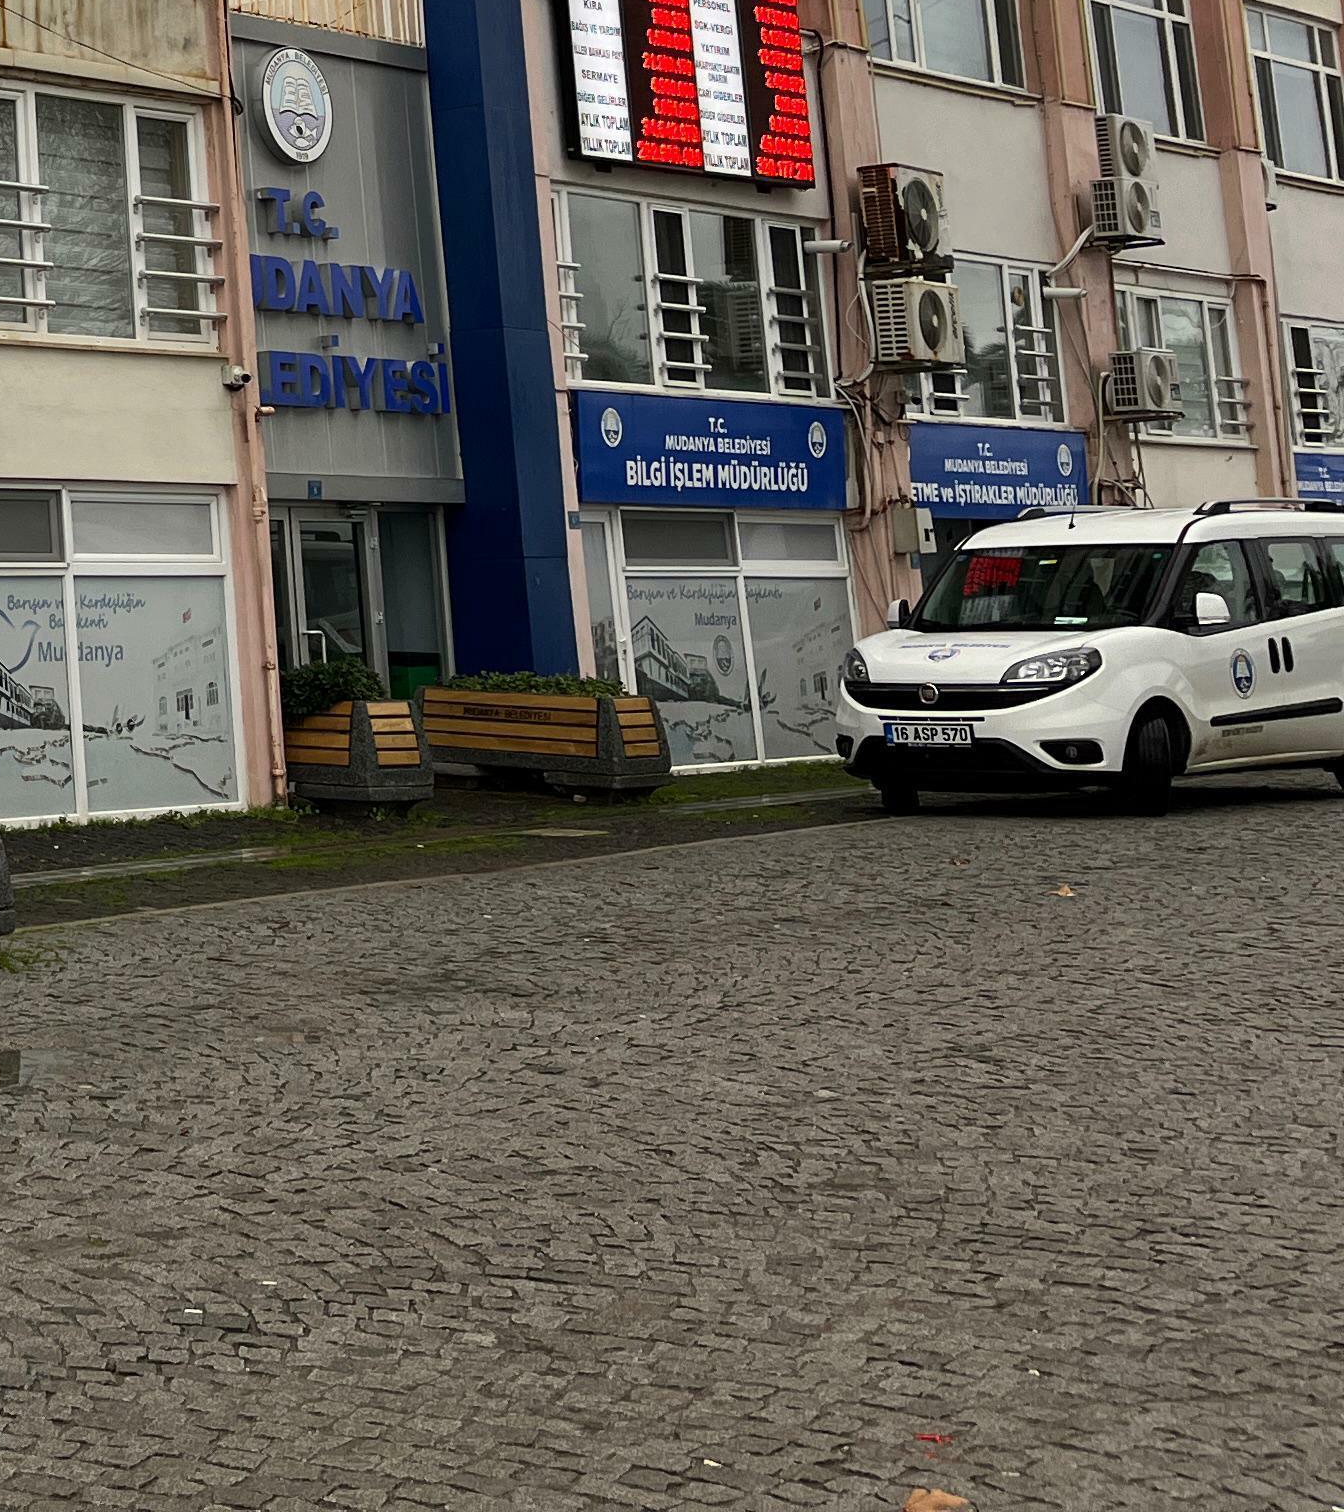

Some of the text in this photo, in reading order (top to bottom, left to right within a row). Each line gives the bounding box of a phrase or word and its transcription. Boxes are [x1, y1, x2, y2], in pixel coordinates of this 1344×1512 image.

[581, 69, 619, 84] SERMAYE
[259, 187, 339, 240] T.C.
[708, 417, 728, 433] T.C.
[665, 434, 771, 455] MUDANYA BELEDİYESİ
[977, 443, 993, 457] T.C.
[625, 455, 808, 492] BİLGİ İŞLEM MÜDÜRLÜĞÜ
[944, 458, 1028, 475] MUDANYA BELEDİYESİ
[941, 487, 954, 502] ve
[954, 479, 1015, 506] İŞTİRAKLER
[695, 612, 737, 629] Mudanya
[894, 727, 968, 742] 16 ASP 570
